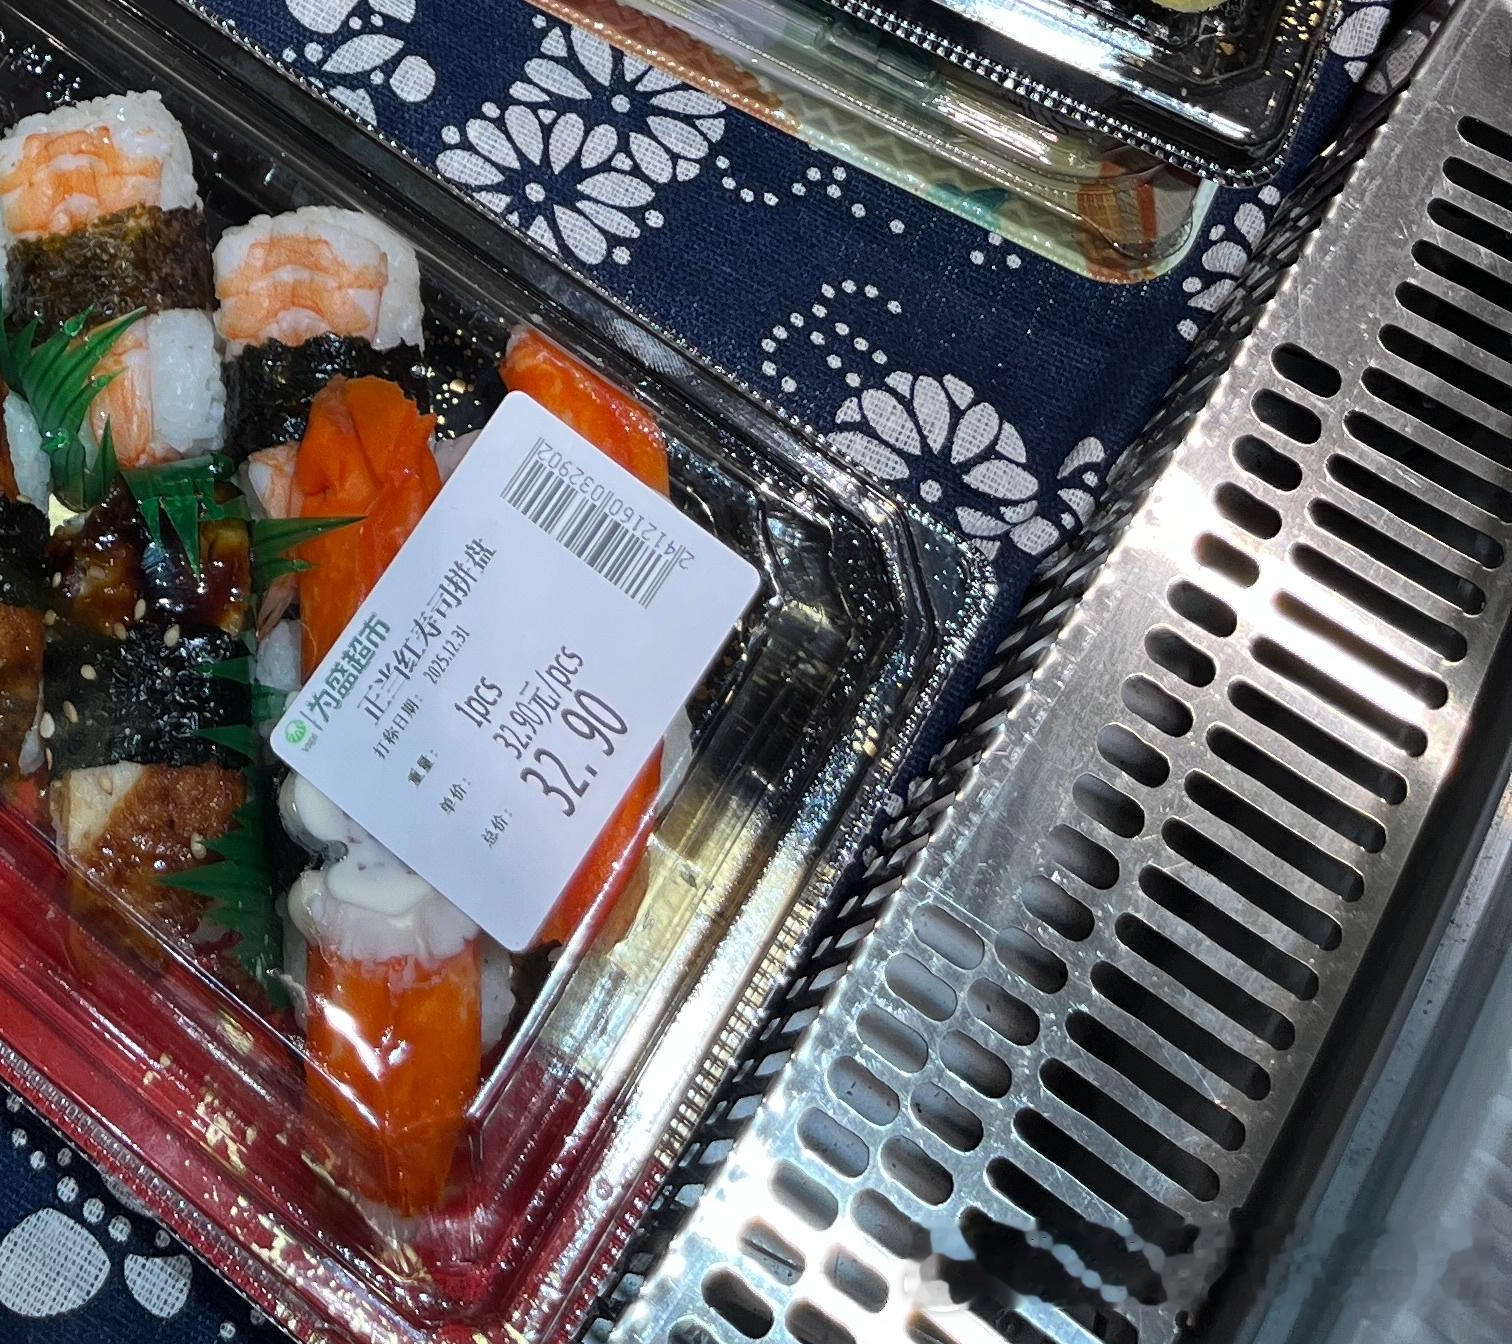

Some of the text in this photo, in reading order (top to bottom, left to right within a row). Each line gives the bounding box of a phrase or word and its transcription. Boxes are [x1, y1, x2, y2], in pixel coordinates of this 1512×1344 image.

[305, 611, 391, 723] 为盛超市
[356, 538, 497, 726] 正当红寿司拼盘
[422, 624, 470, 685] 2025.12.31
[453, 675, 503, 728] 1pcs
[491, 644, 584, 760] 32.90元/pcs
[519, 688, 628, 817] 32.90
